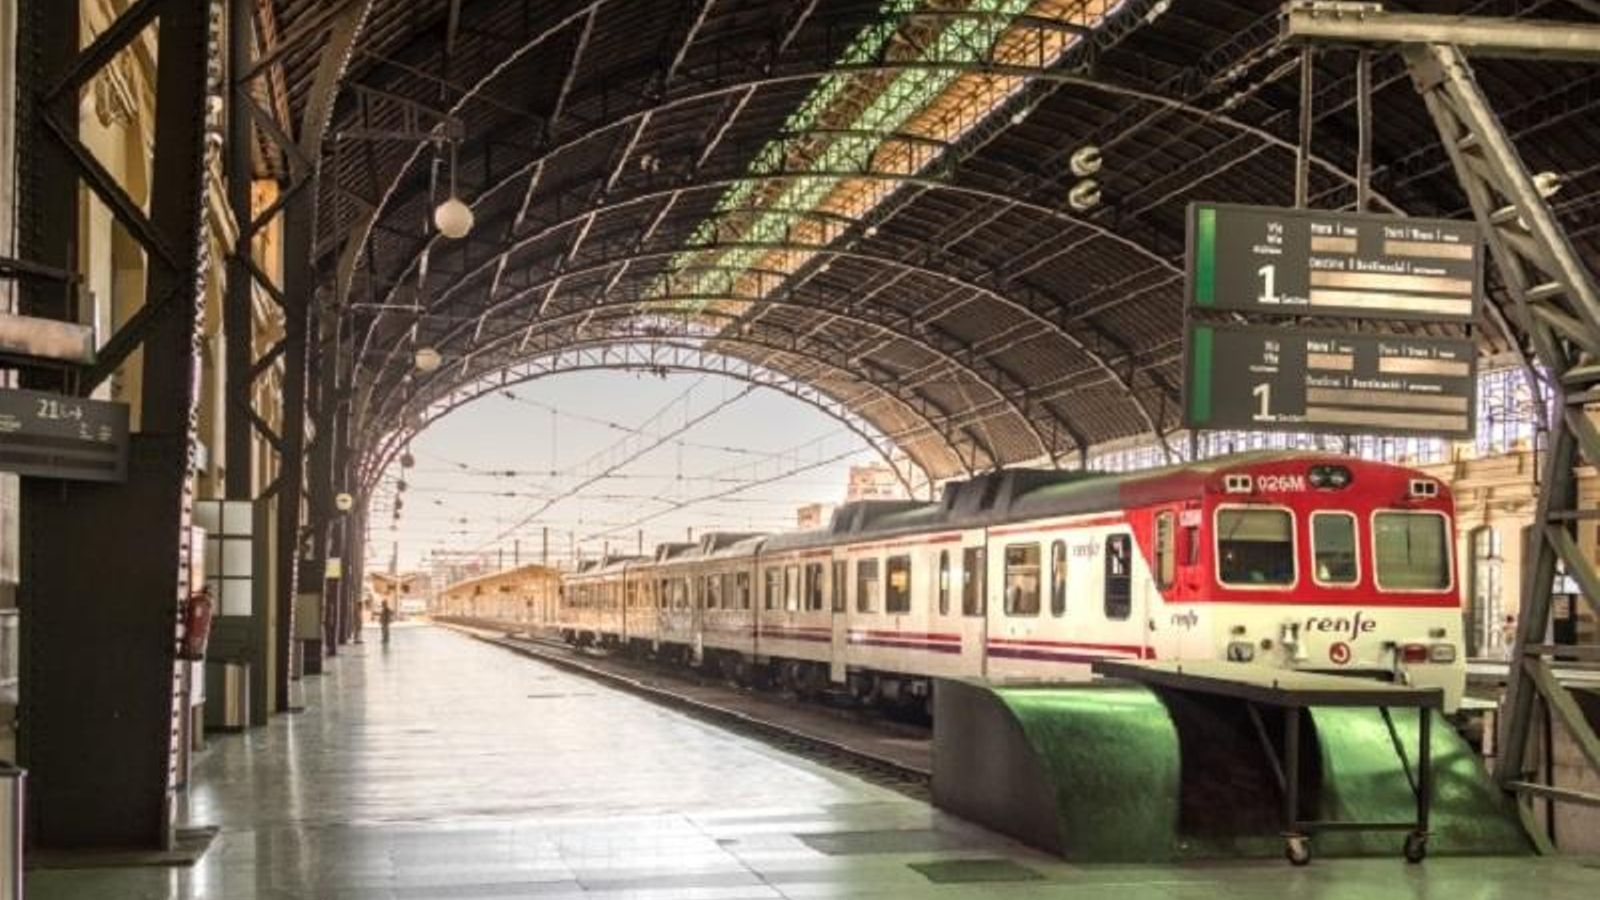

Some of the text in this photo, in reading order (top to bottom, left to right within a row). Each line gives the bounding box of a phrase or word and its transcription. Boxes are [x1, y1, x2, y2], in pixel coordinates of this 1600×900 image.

[1258, 264, 1280, 304] 1
[1252, 383, 1277, 420] 1
[1257, 474, 1306, 492] 026M
[1305, 610, 1377, 641] renfe
